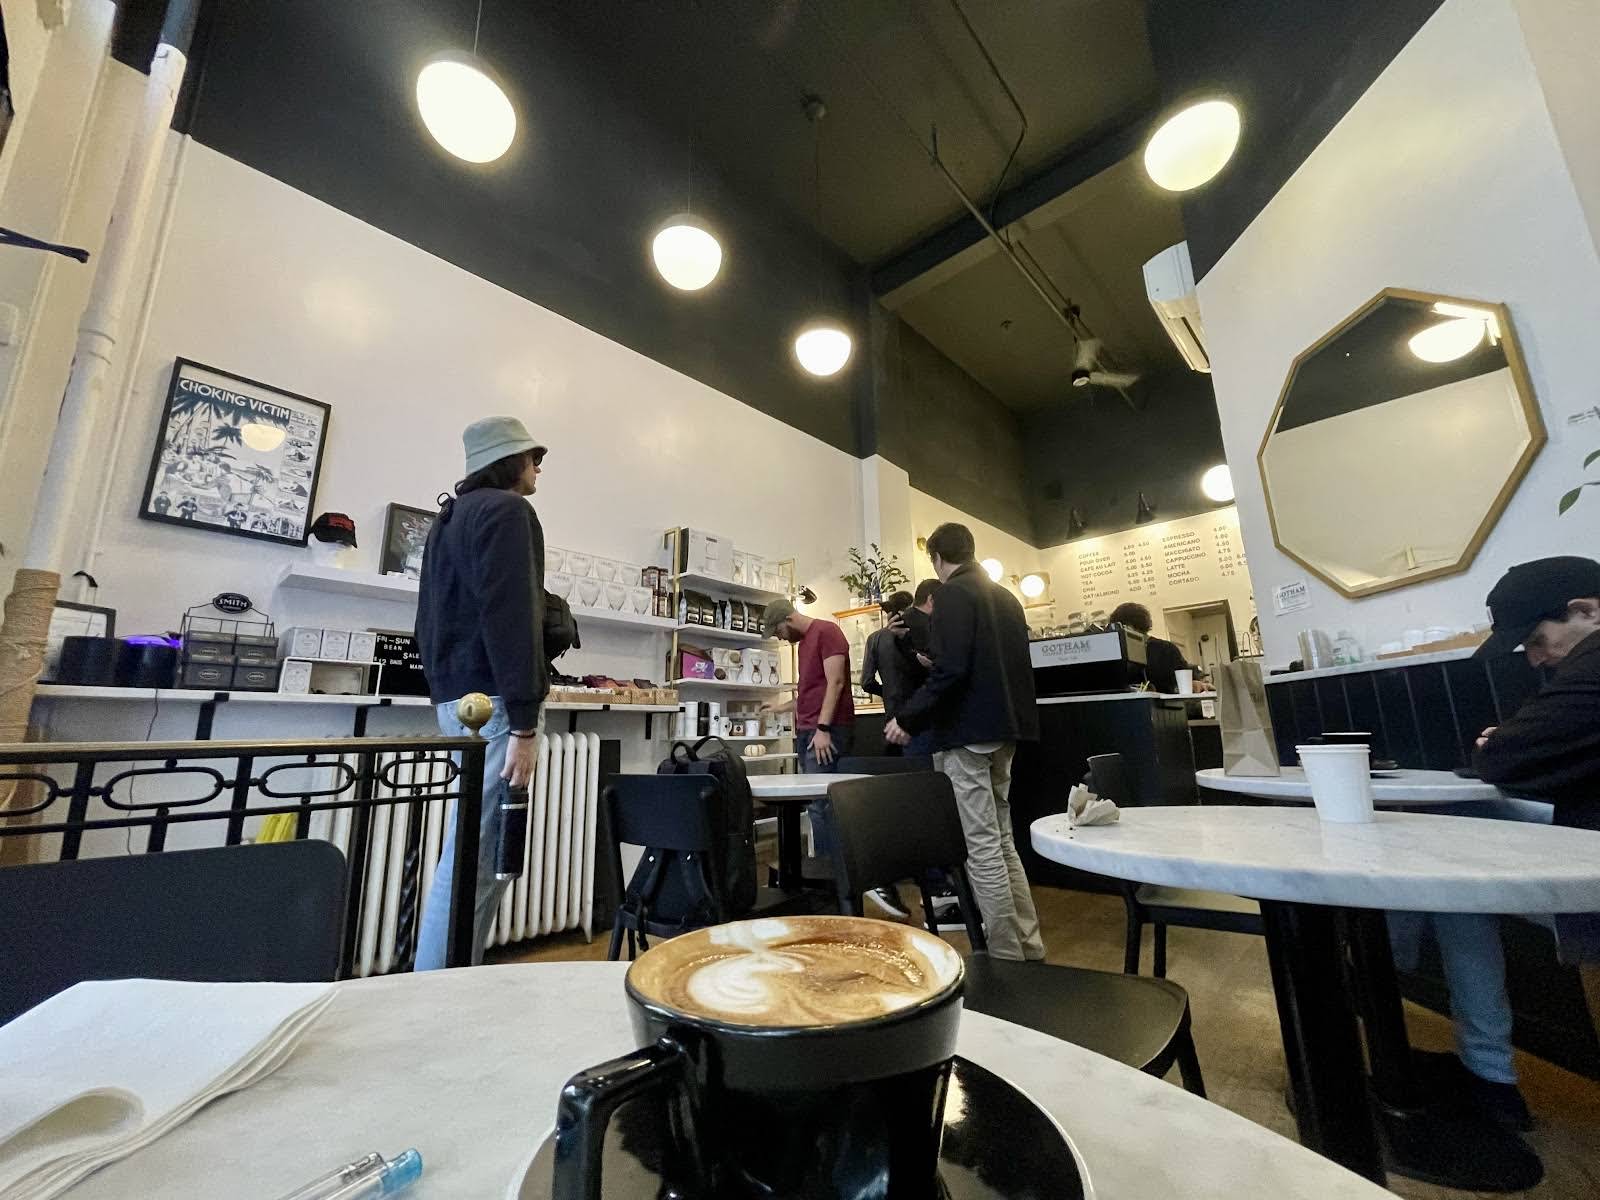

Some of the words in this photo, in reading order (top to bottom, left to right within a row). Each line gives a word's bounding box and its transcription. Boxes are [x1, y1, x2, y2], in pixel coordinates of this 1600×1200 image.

[180, 379, 246, 407] CHOKING
[1162, 531, 1195, 542] ESPRESSO
[1164, 538, 1201, 549] AMERICANO
[1166, 552, 1206, 564] CAPPUCCINO
[1167, 563, 1185, 571] LATTE
[1168, 570, 1190, 578] MOCHA
[1169, 577, 1200, 585] CORTADO
[218, 598, 247, 608] SMITH
[377, 635, 388, 643] FRI
[395, 637, 410, 645] SUN
[1041, 640, 1089, 653] GOTHAM
[403, 652, 420, 660] SALE
